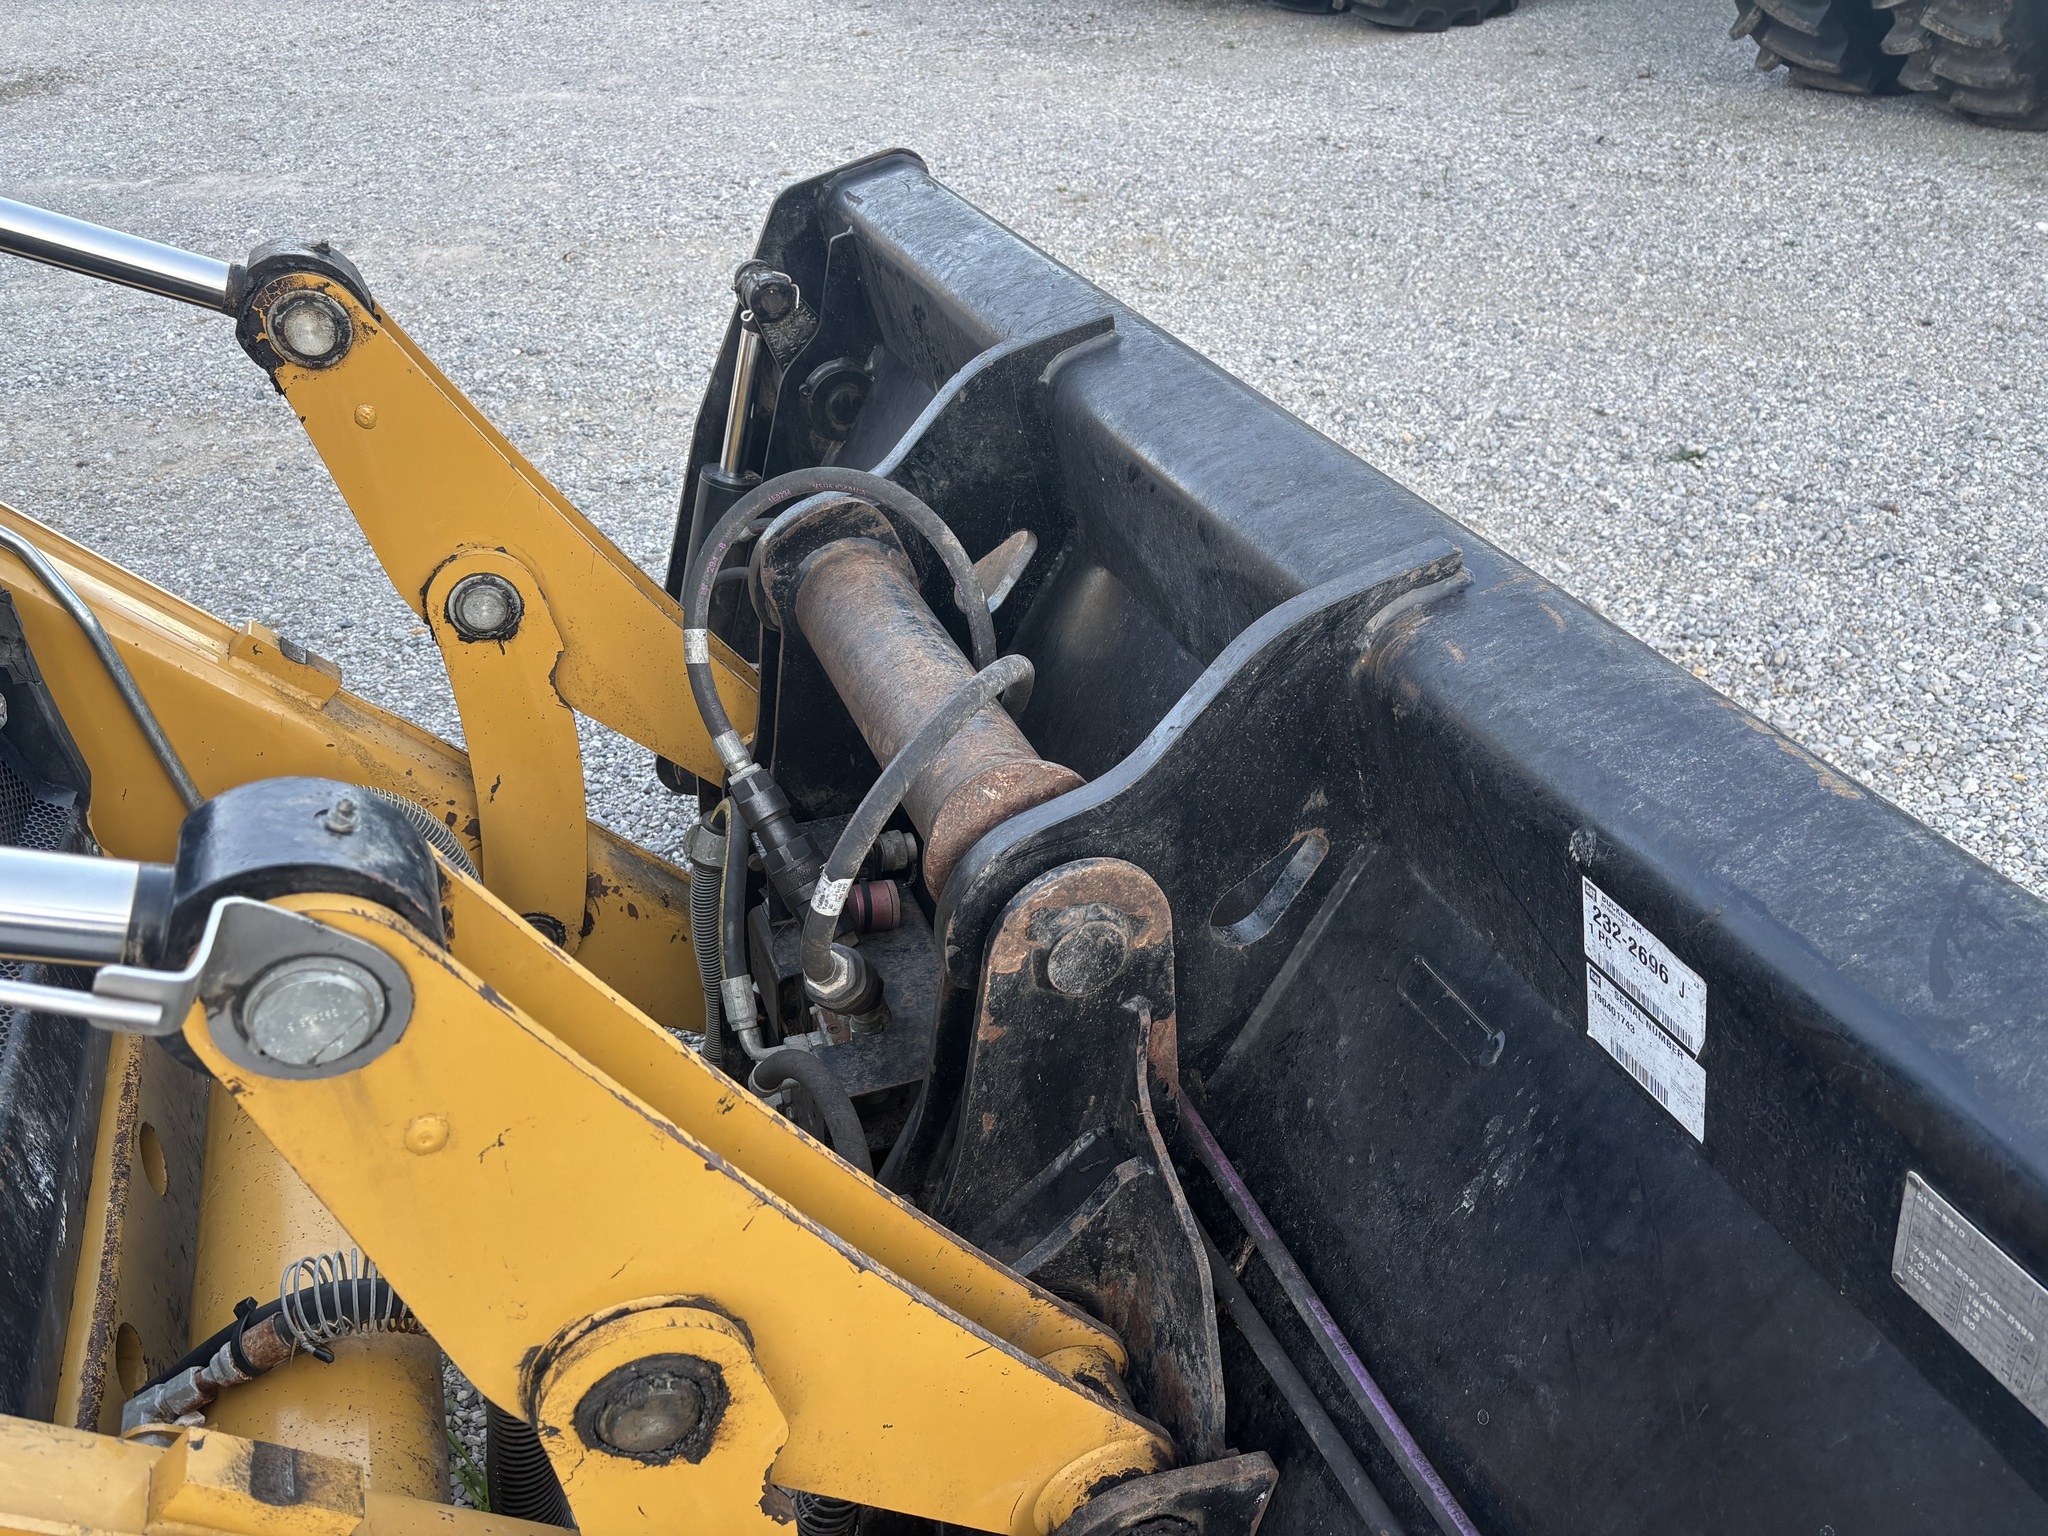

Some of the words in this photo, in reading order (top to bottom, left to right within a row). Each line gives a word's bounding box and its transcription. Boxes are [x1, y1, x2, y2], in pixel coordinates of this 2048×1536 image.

[1588, 922, 1594, 935] 1
[1598, 931, 1612, 950] PC
[1592, 904, 1669, 985] 232-2696
[1614, 990, 1643, 1024] SERIAL
[1645, 1020, 1684, 1061] NUMBER
